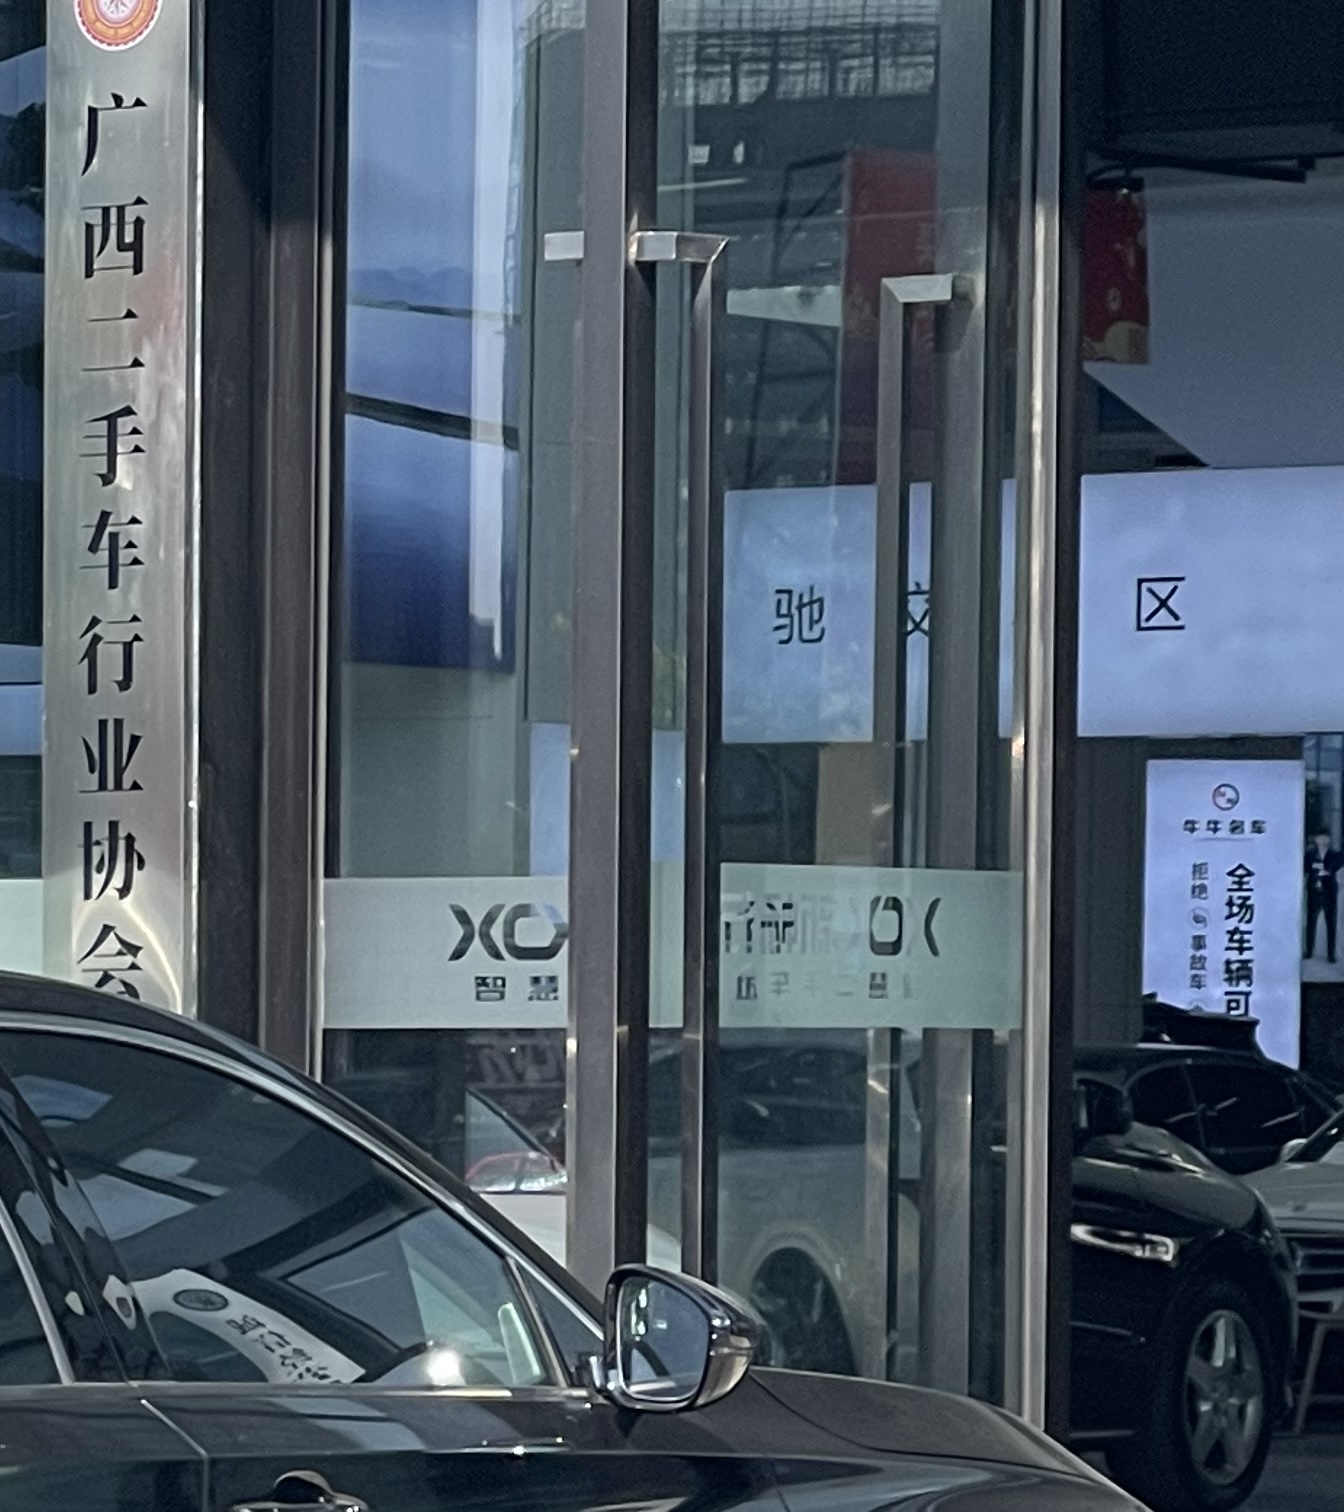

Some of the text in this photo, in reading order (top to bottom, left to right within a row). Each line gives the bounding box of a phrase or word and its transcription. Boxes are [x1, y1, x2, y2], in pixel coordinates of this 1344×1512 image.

[78, 91, 149, 1002] 广西二手车行业协会
